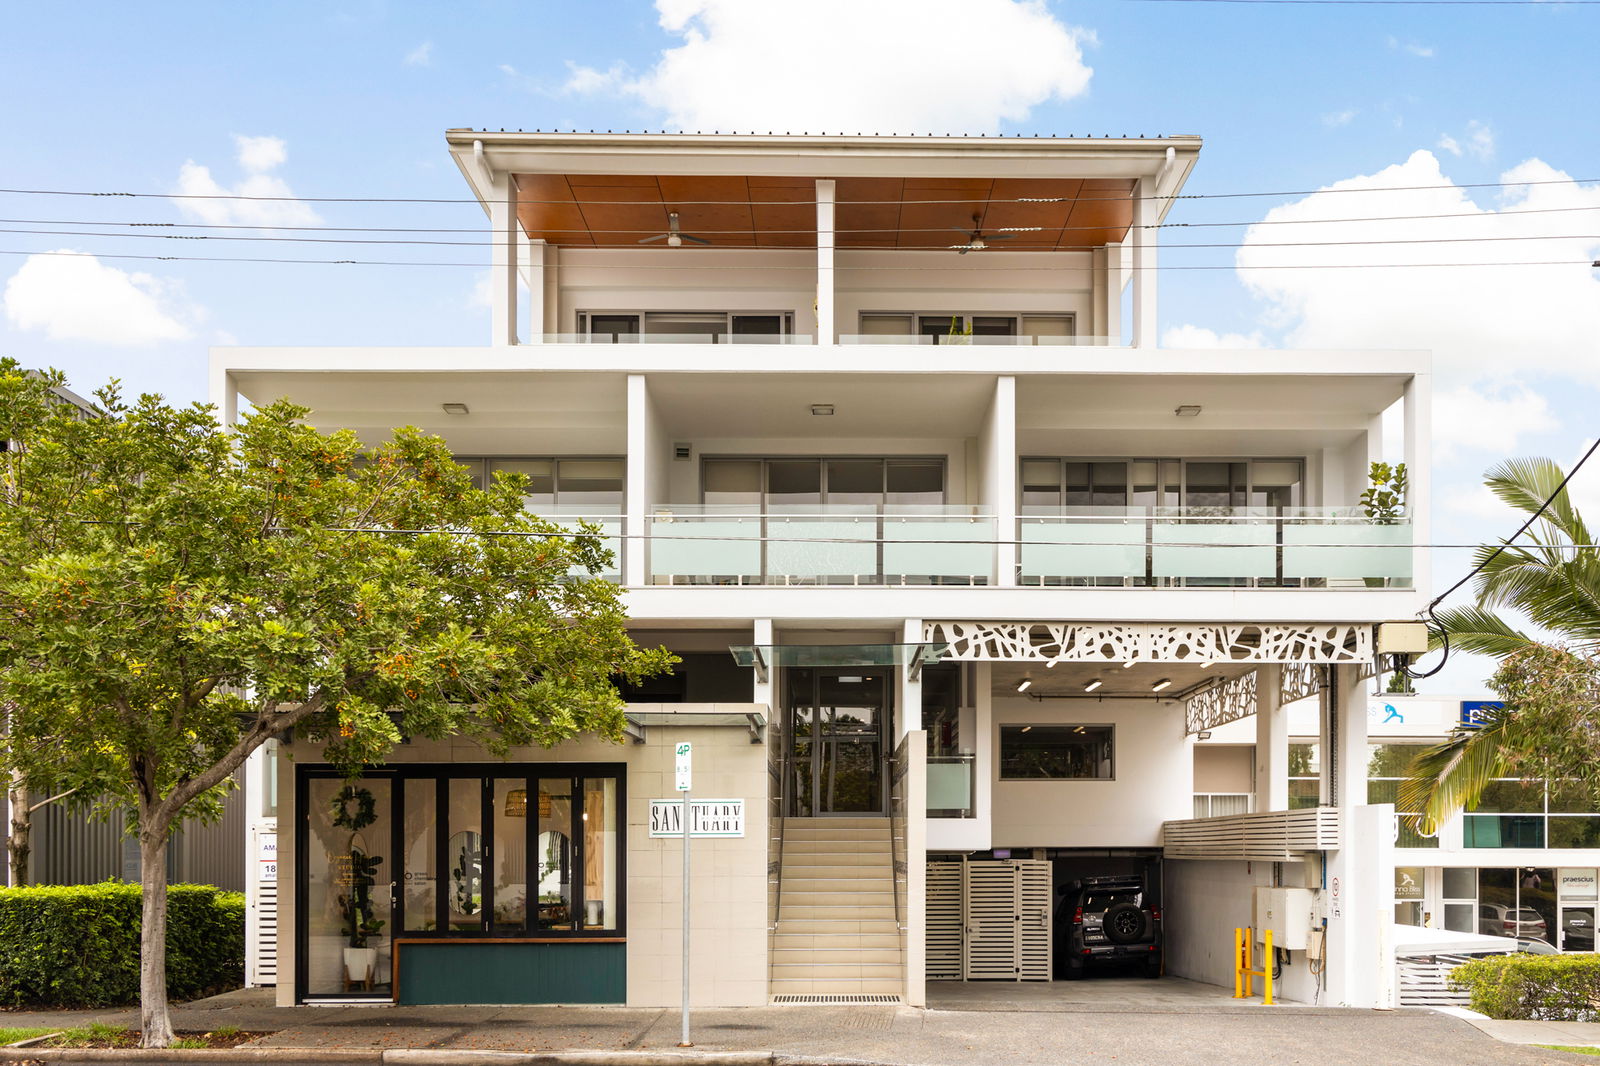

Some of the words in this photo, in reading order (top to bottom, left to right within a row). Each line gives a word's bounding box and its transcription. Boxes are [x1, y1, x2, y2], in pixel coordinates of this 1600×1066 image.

[677, 744, 690, 756] 4P
[652, 805, 742, 832] SANTUARY
[1562, 876, 1594, 884] praescius
